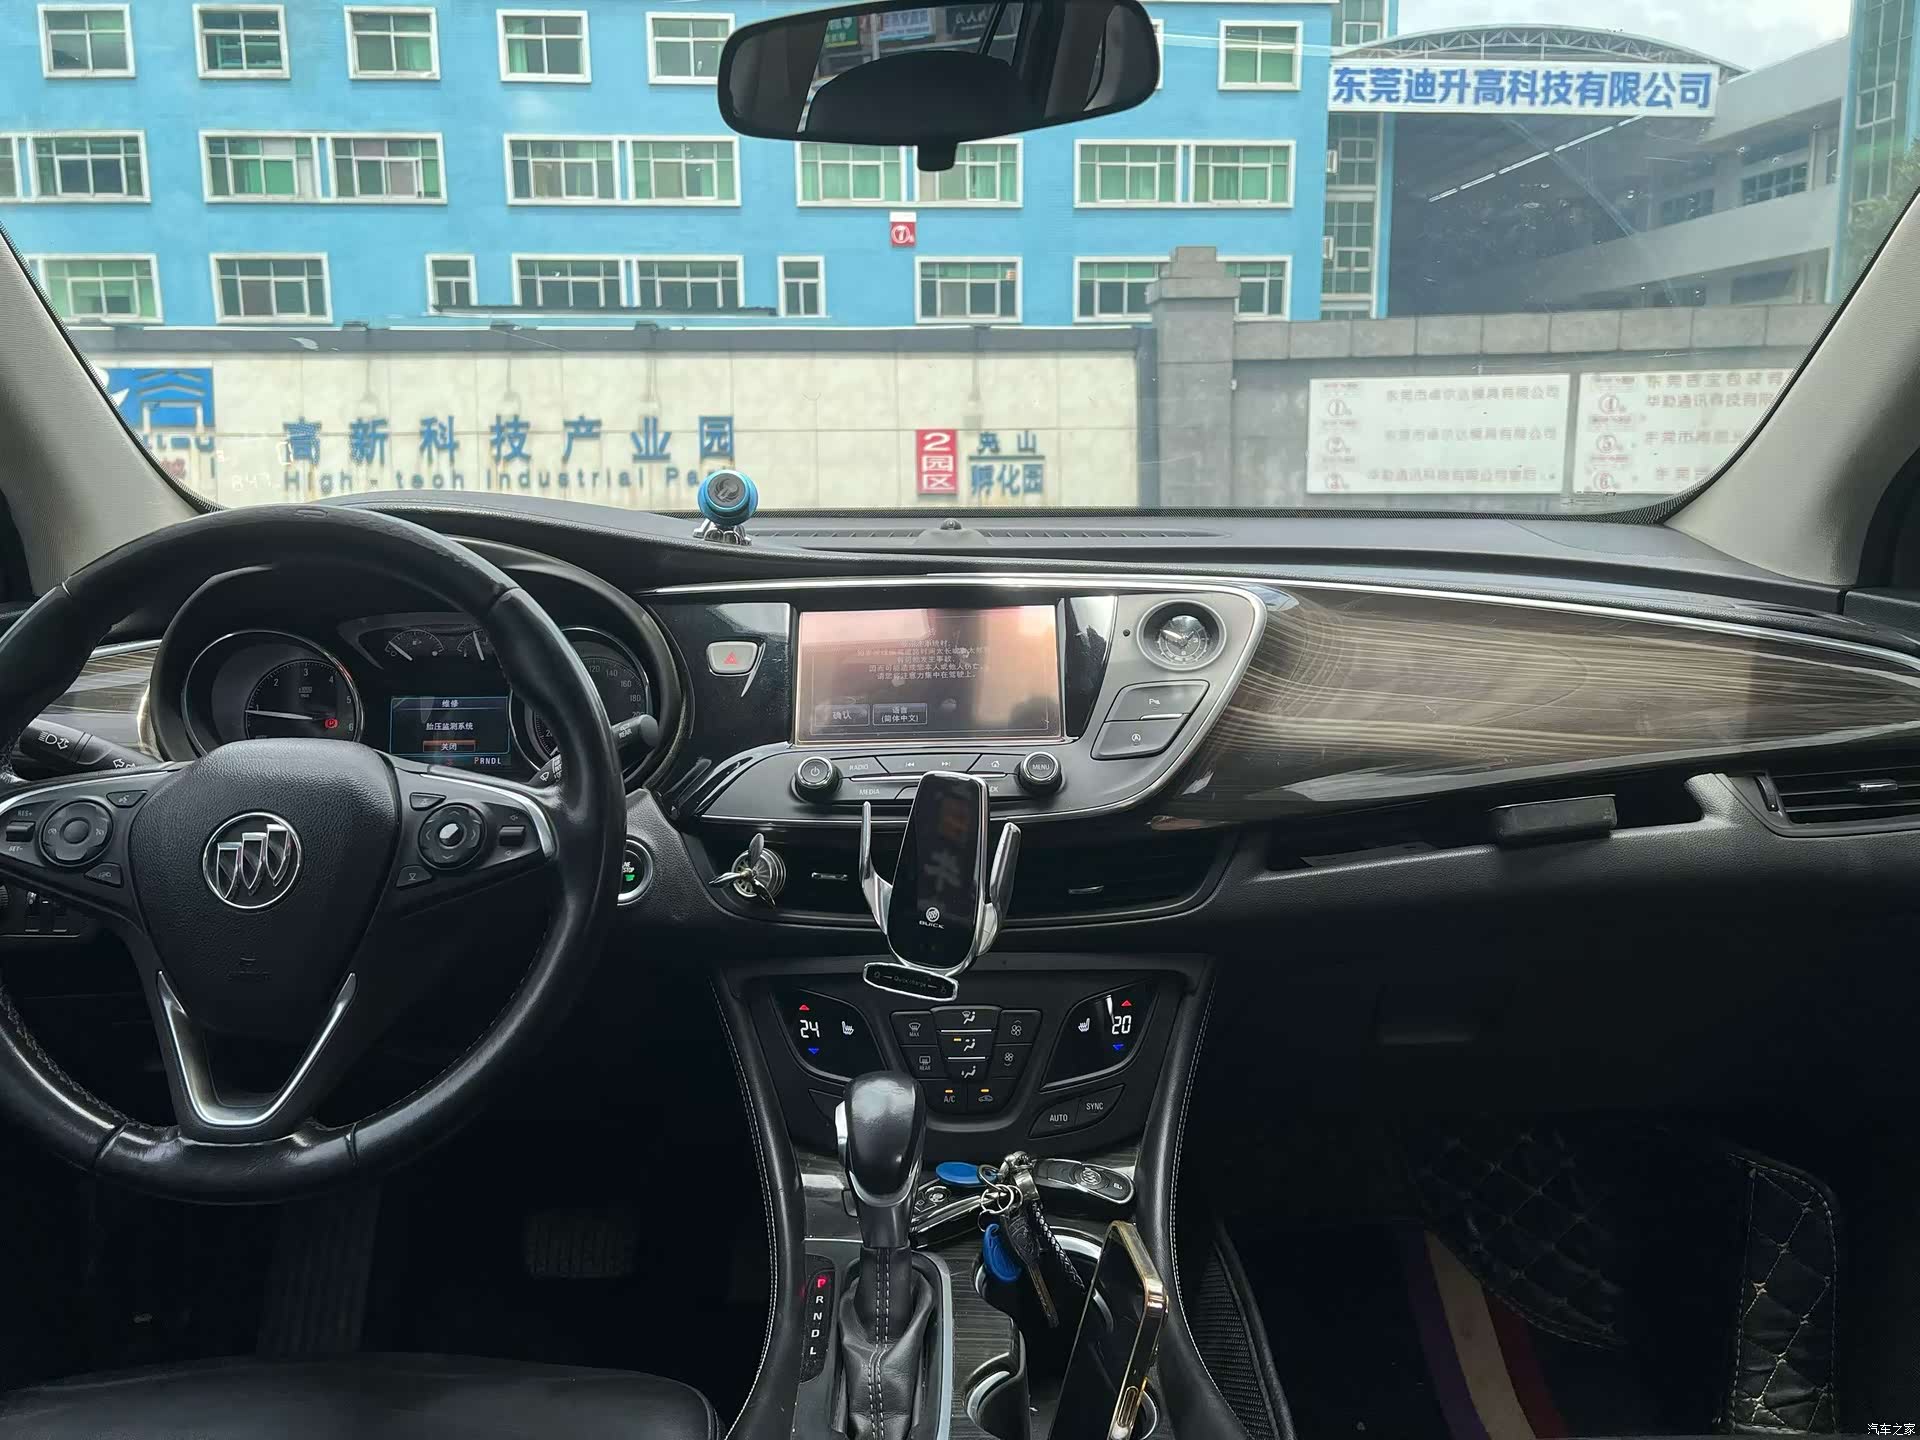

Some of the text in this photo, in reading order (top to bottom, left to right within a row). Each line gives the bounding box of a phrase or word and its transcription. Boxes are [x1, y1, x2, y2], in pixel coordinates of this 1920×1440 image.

[1332, 67, 1713, 109] 东莞迪升高科技有限公司
[283, 415, 735, 465] 高新科技产业园
[922, 432, 955, 490] 2园区
[487, 467, 644, 488] Industrial
[441, 699, 459, 708] 维修
[832, 710, 852, 720] 确认
[881, 714, 919, 723] (简体中文)
[426, 721, 474, 731] 胎压监测系统
[441, 743, 458, 751] 关闭
[859, 788, 880, 796] MEDIA
[919, 920, 945, 930] BUICK
[800, 1019, 820, 1038] 24
[1111, 1015, 1132, 1034] 20
[1086, 1102, 1104, 1110] SYNC
[1050, 1114, 1068, 1122] AUTO
